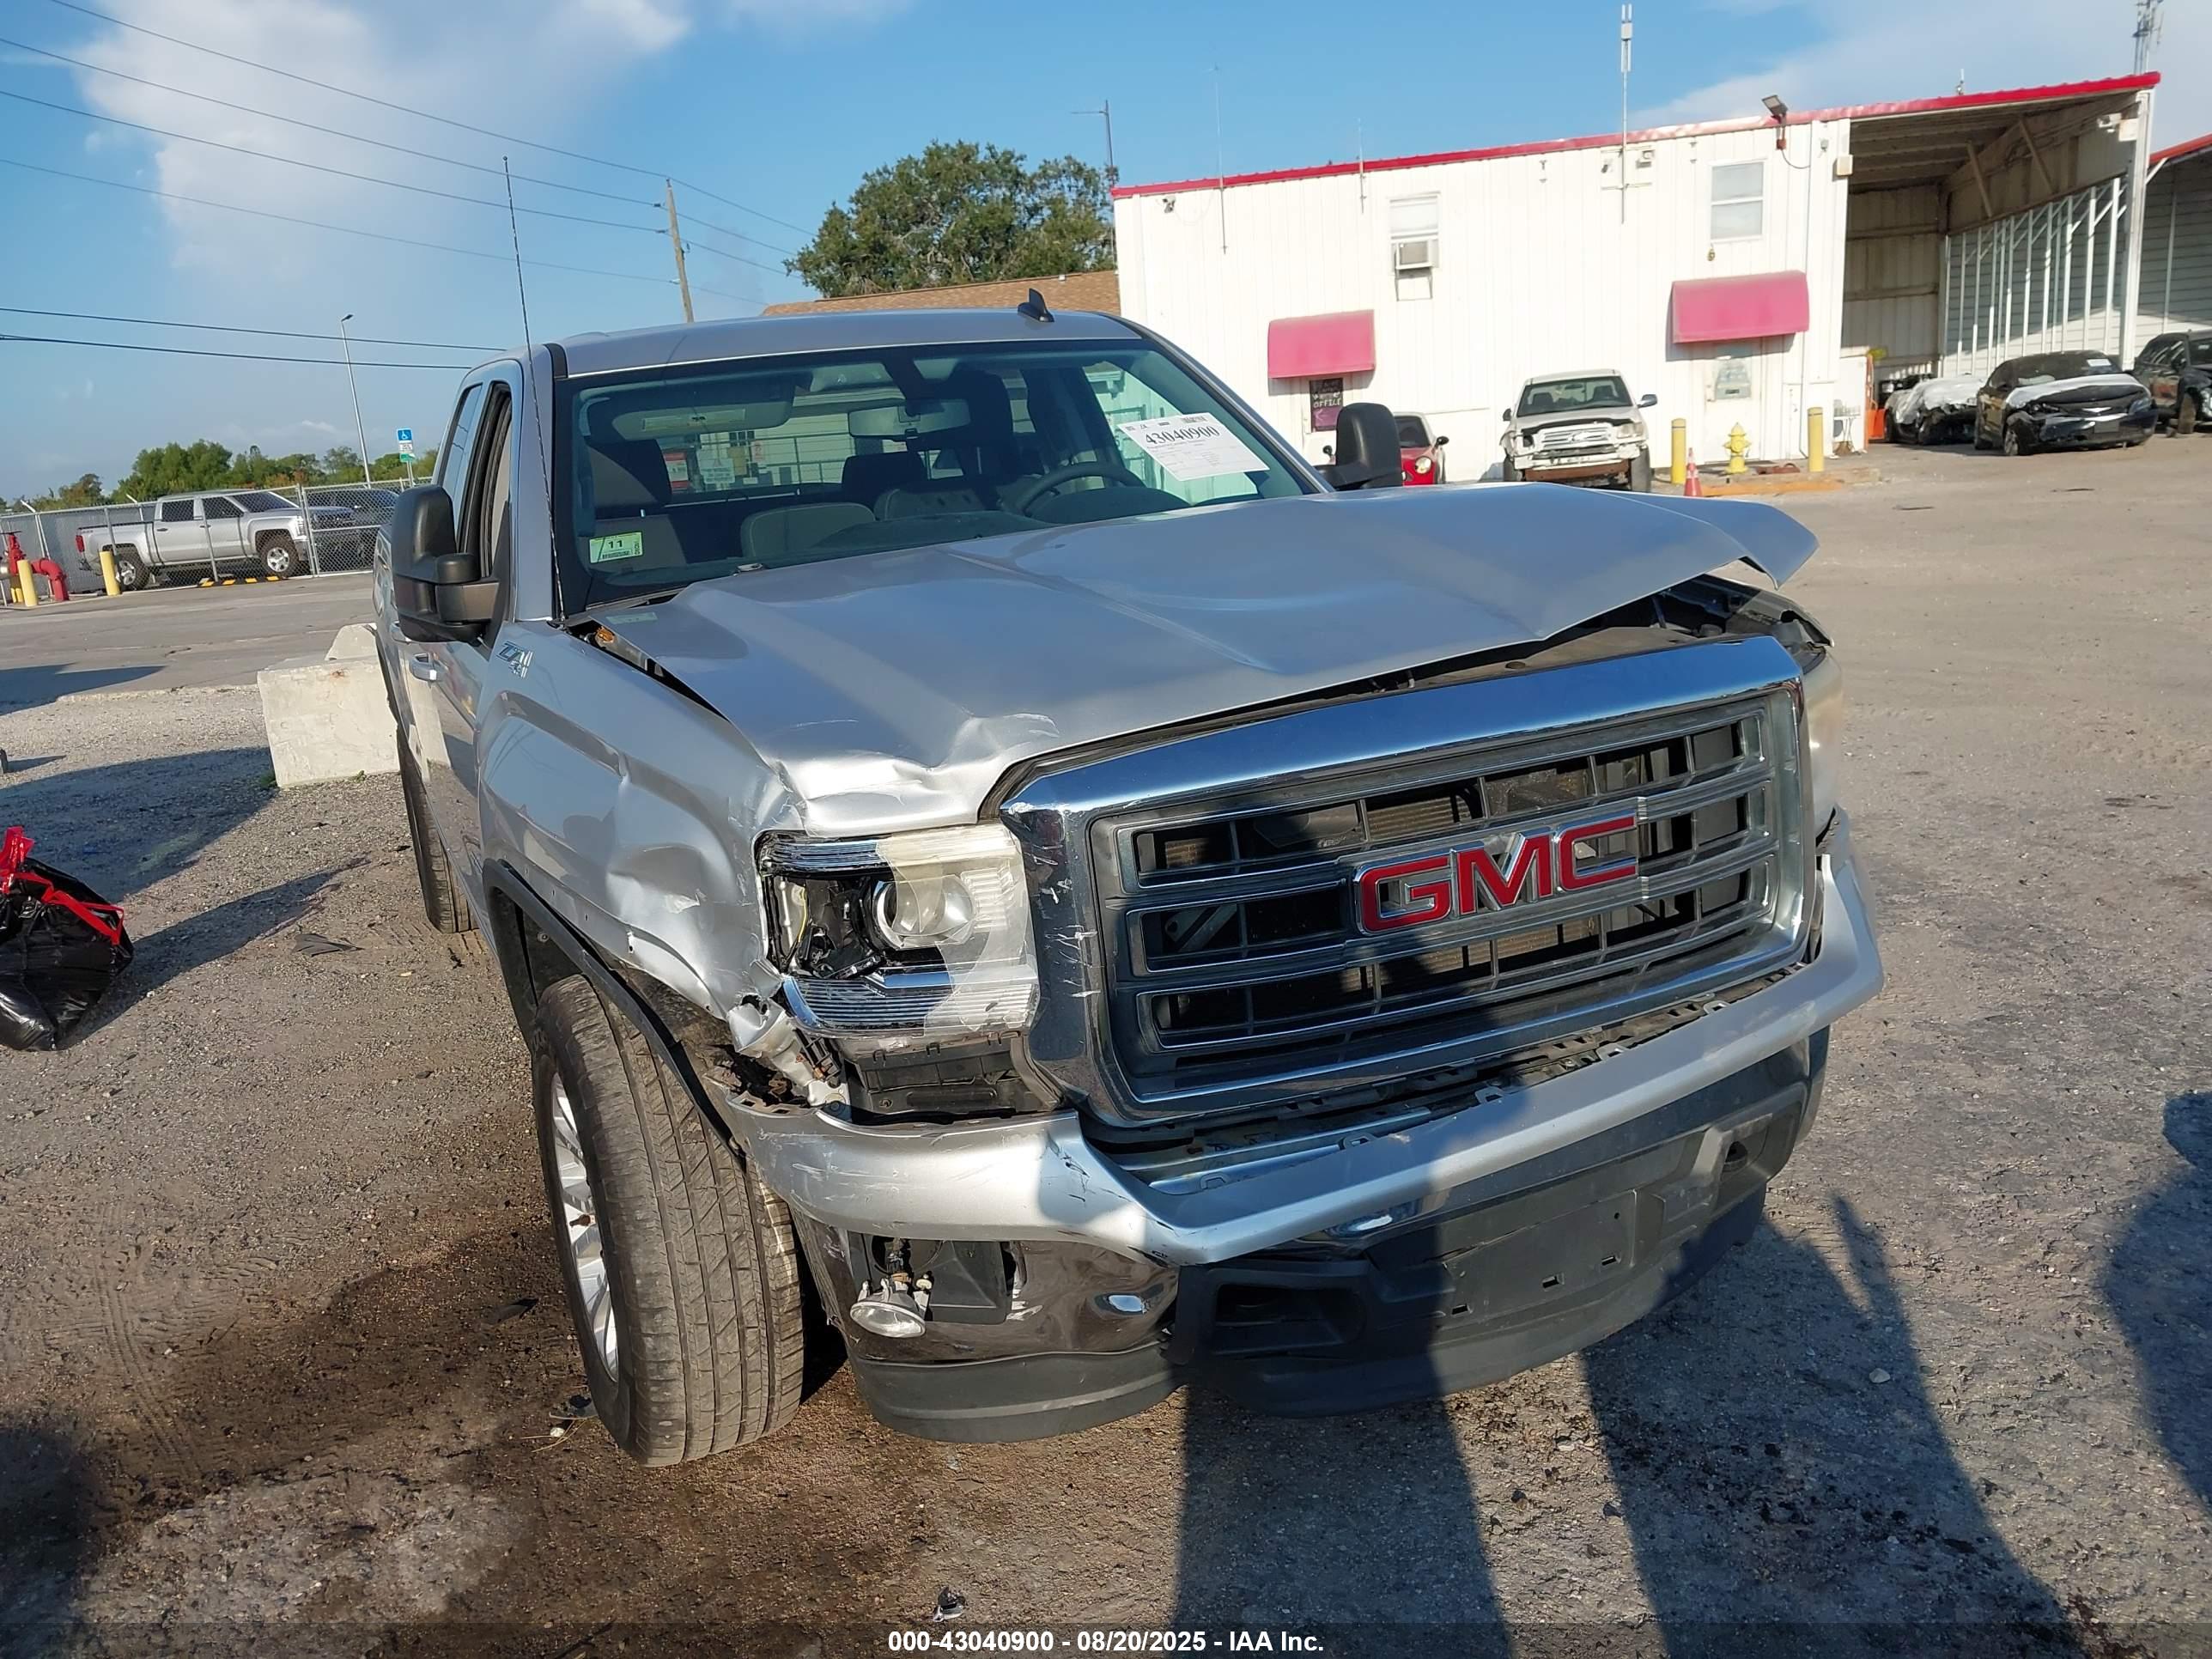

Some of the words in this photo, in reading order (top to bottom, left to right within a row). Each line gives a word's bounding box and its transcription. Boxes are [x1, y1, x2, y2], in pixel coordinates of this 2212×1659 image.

[1146, 424, 1220, 445] 43040900
[609, 540, 622, 549] 11
[1354, 812, 1637, 935] GMC
